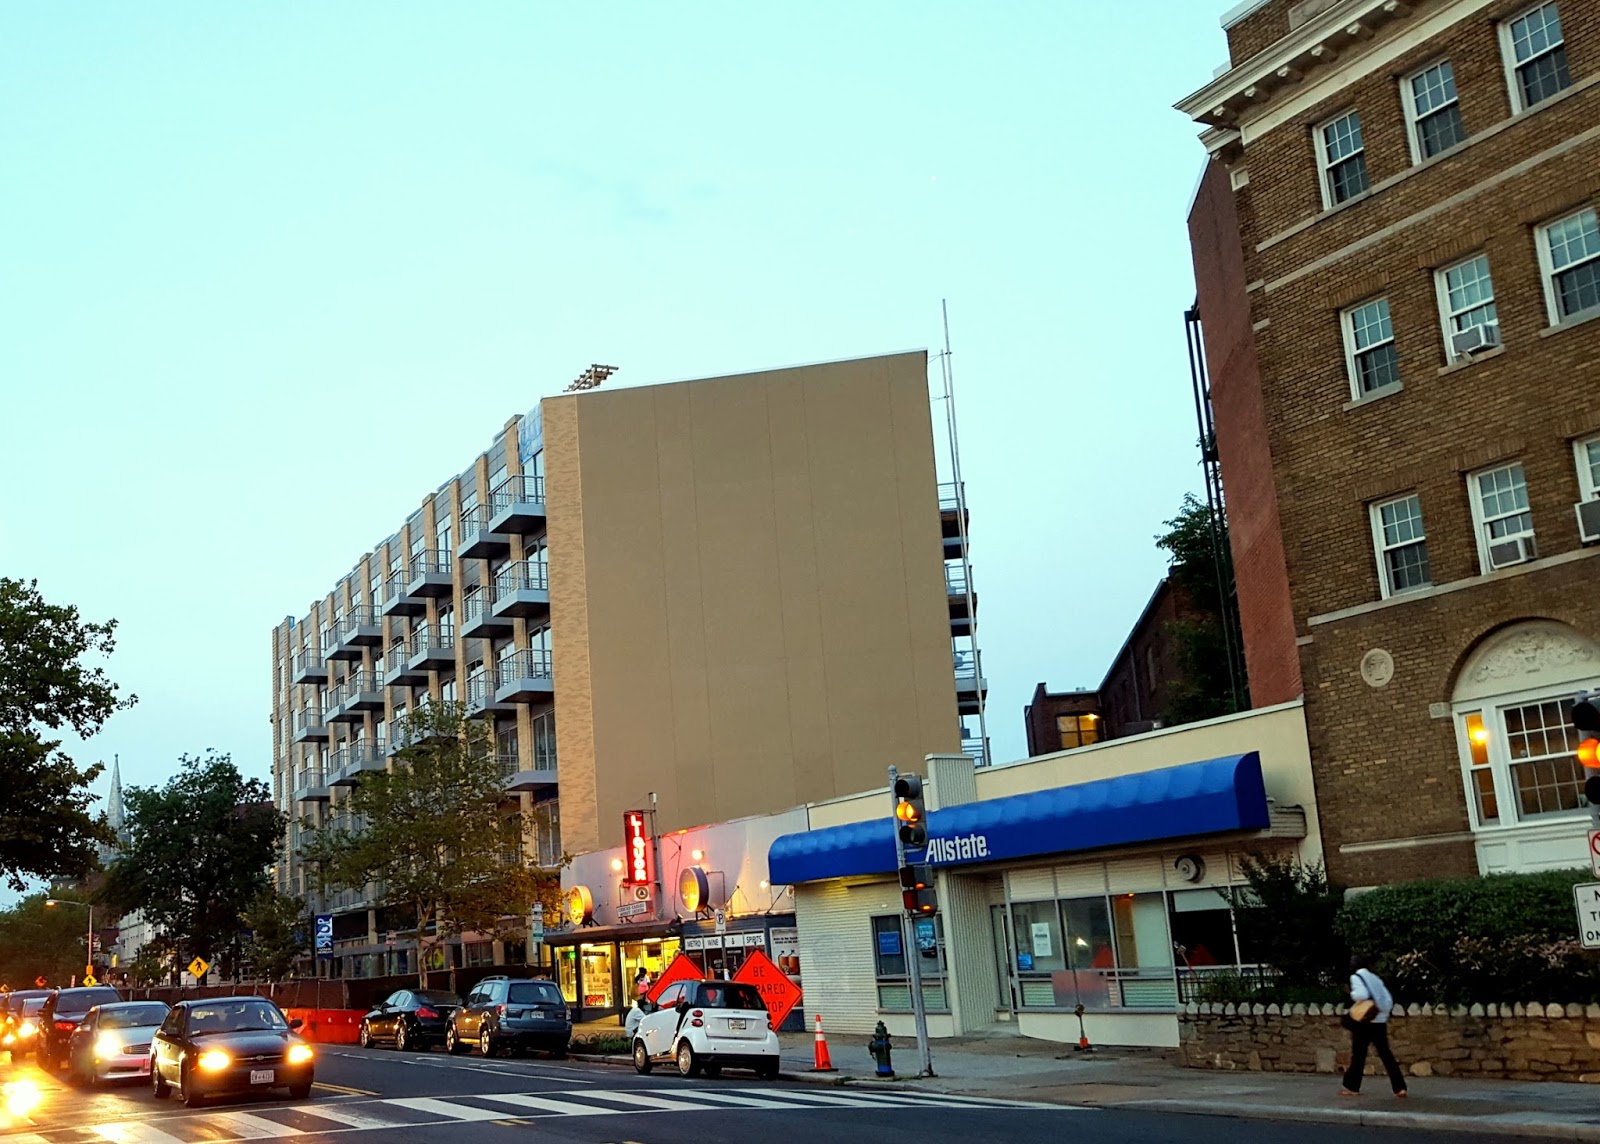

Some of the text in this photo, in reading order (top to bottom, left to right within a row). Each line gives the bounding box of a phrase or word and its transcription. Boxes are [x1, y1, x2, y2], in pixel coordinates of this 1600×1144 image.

[631, 814, 646, 881] LIQUOR
[925, 833, 987, 863] Allstate
[1590, 911, 1600, 922] T
[317, 918, 333, 948] SHOP
[687, 935, 762, 948] METRO WINE & SPIRITS
[753, 966, 765, 977] BE
[755, 983, 785, 995] PARED
[766, 1001, 784, 1013] TOP
